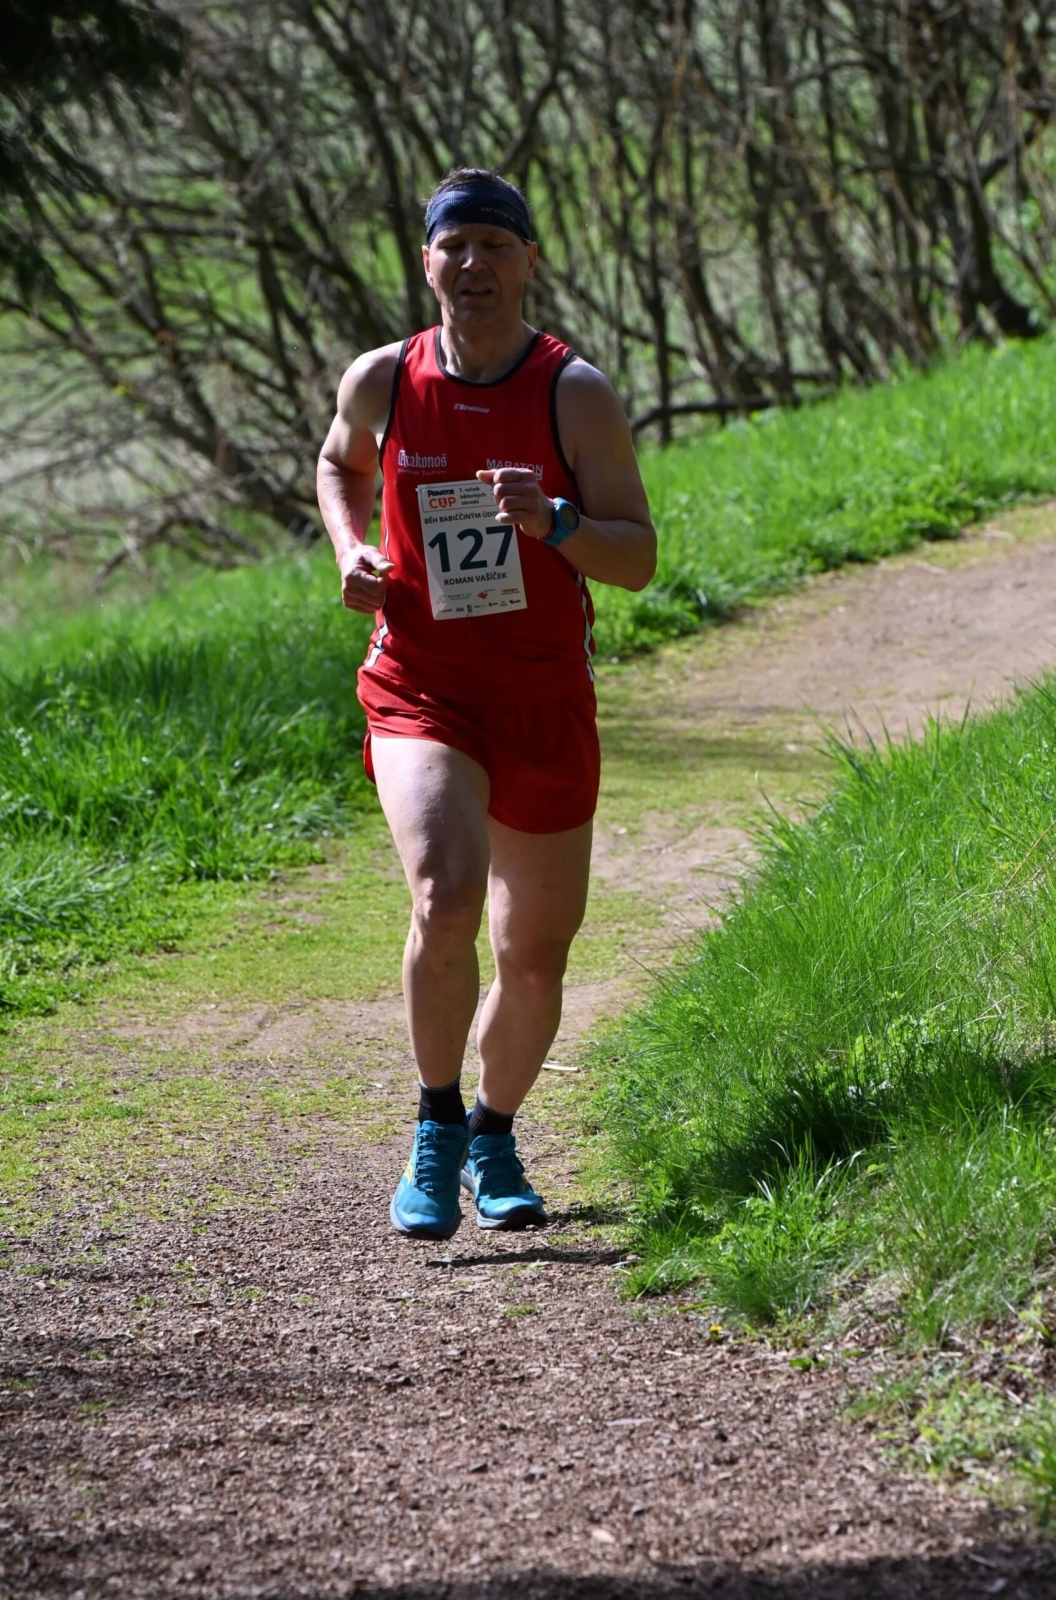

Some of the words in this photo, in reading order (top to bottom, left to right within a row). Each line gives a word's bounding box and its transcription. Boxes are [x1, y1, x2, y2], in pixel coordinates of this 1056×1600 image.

[398, 449, 447, 469] Krakonoš
[428, 496, 457, 510] CUP
[459, 492, 487, 500] běžeckých
[424, 516, 438, 524] BĚH
[439, 511, 482, 523] BABIČČINÝM
[428, 525, 514, 573] 127
[443, 576, 475, 586] ROMAN
[475, 572, 508, 583] VAŠÍČEK
